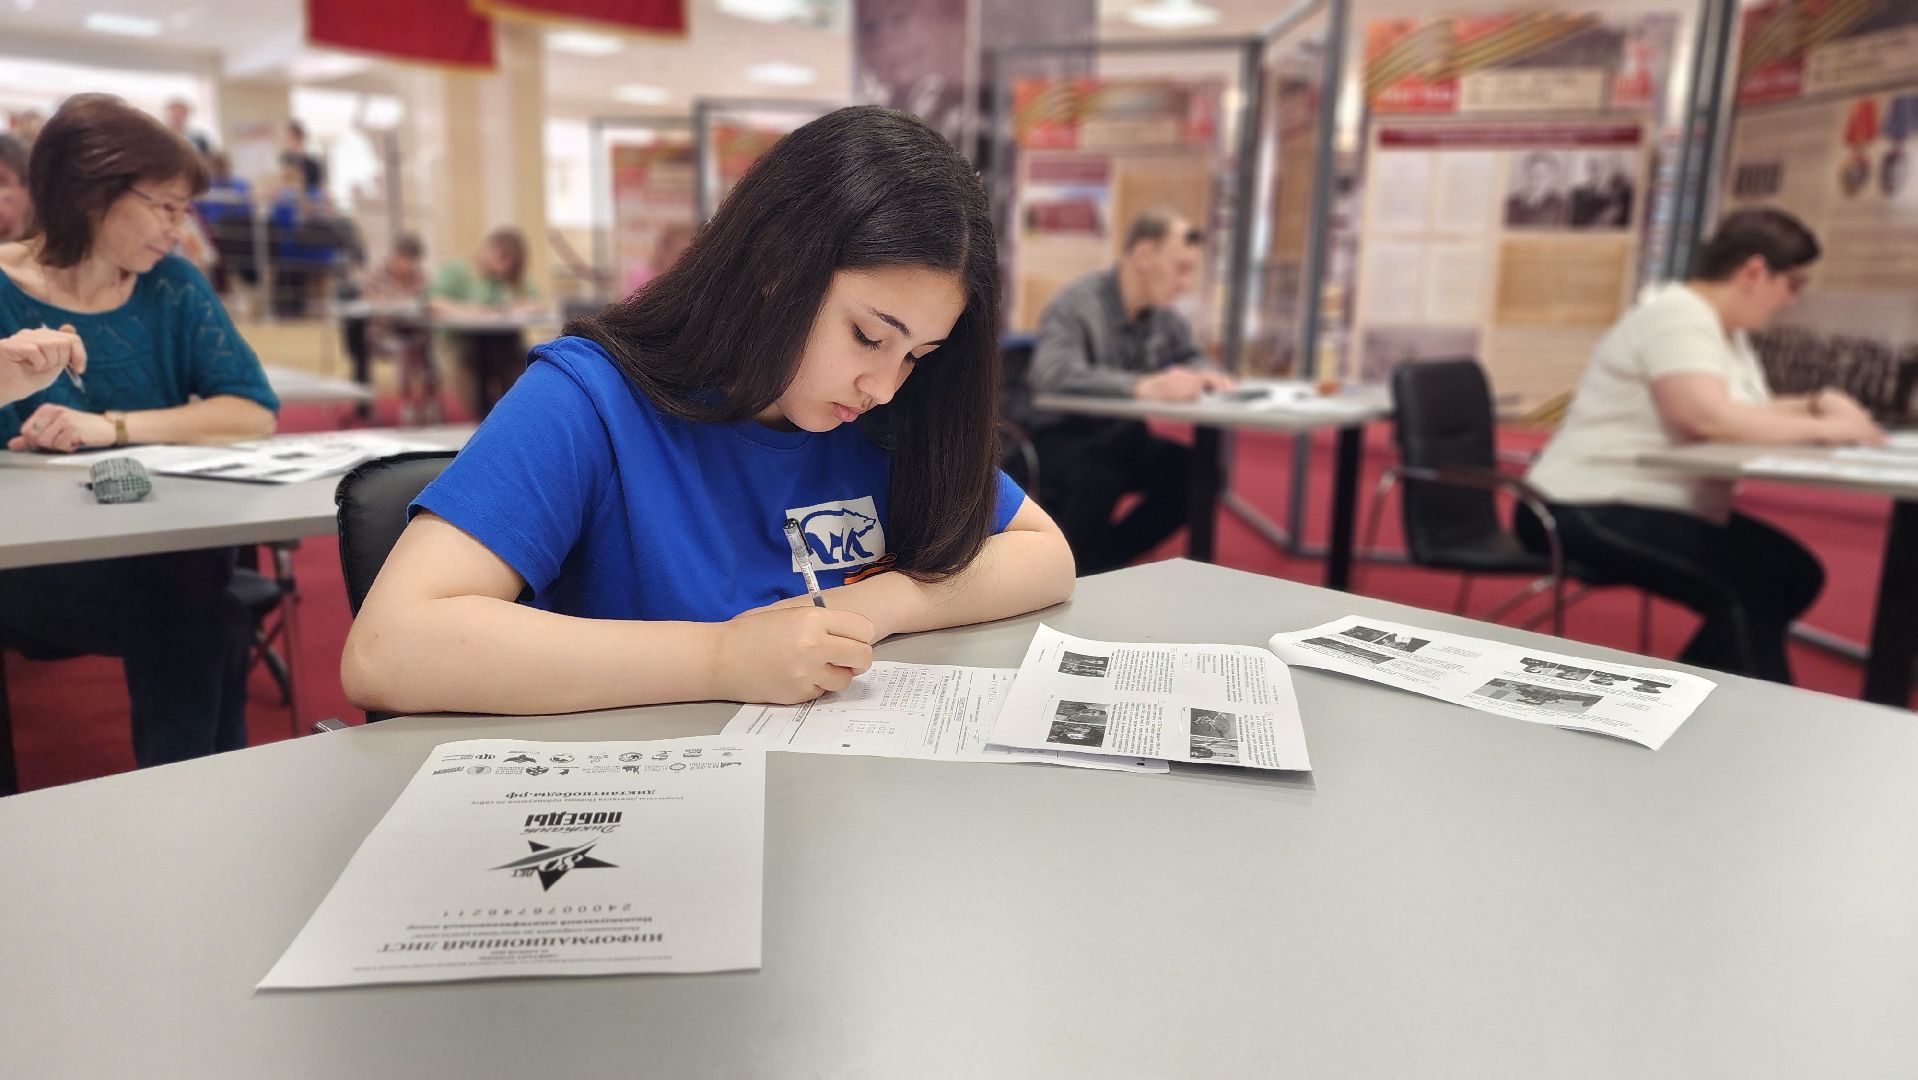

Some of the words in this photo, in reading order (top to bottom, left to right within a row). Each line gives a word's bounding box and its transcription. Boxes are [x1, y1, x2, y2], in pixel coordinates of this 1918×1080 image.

[506, 789, 656, 799] диктантпобеды.рф
[525, 811, 622, 827] ПОБЕДЫ
[520, 824, 621, 835] Диктант
[511, 869, 535, 878] ЛЕТ
[380, 941, 438, 953] ЛИСТ
[442, 933, 663, 951] ИНФОРМАЦИОННЫЙ
